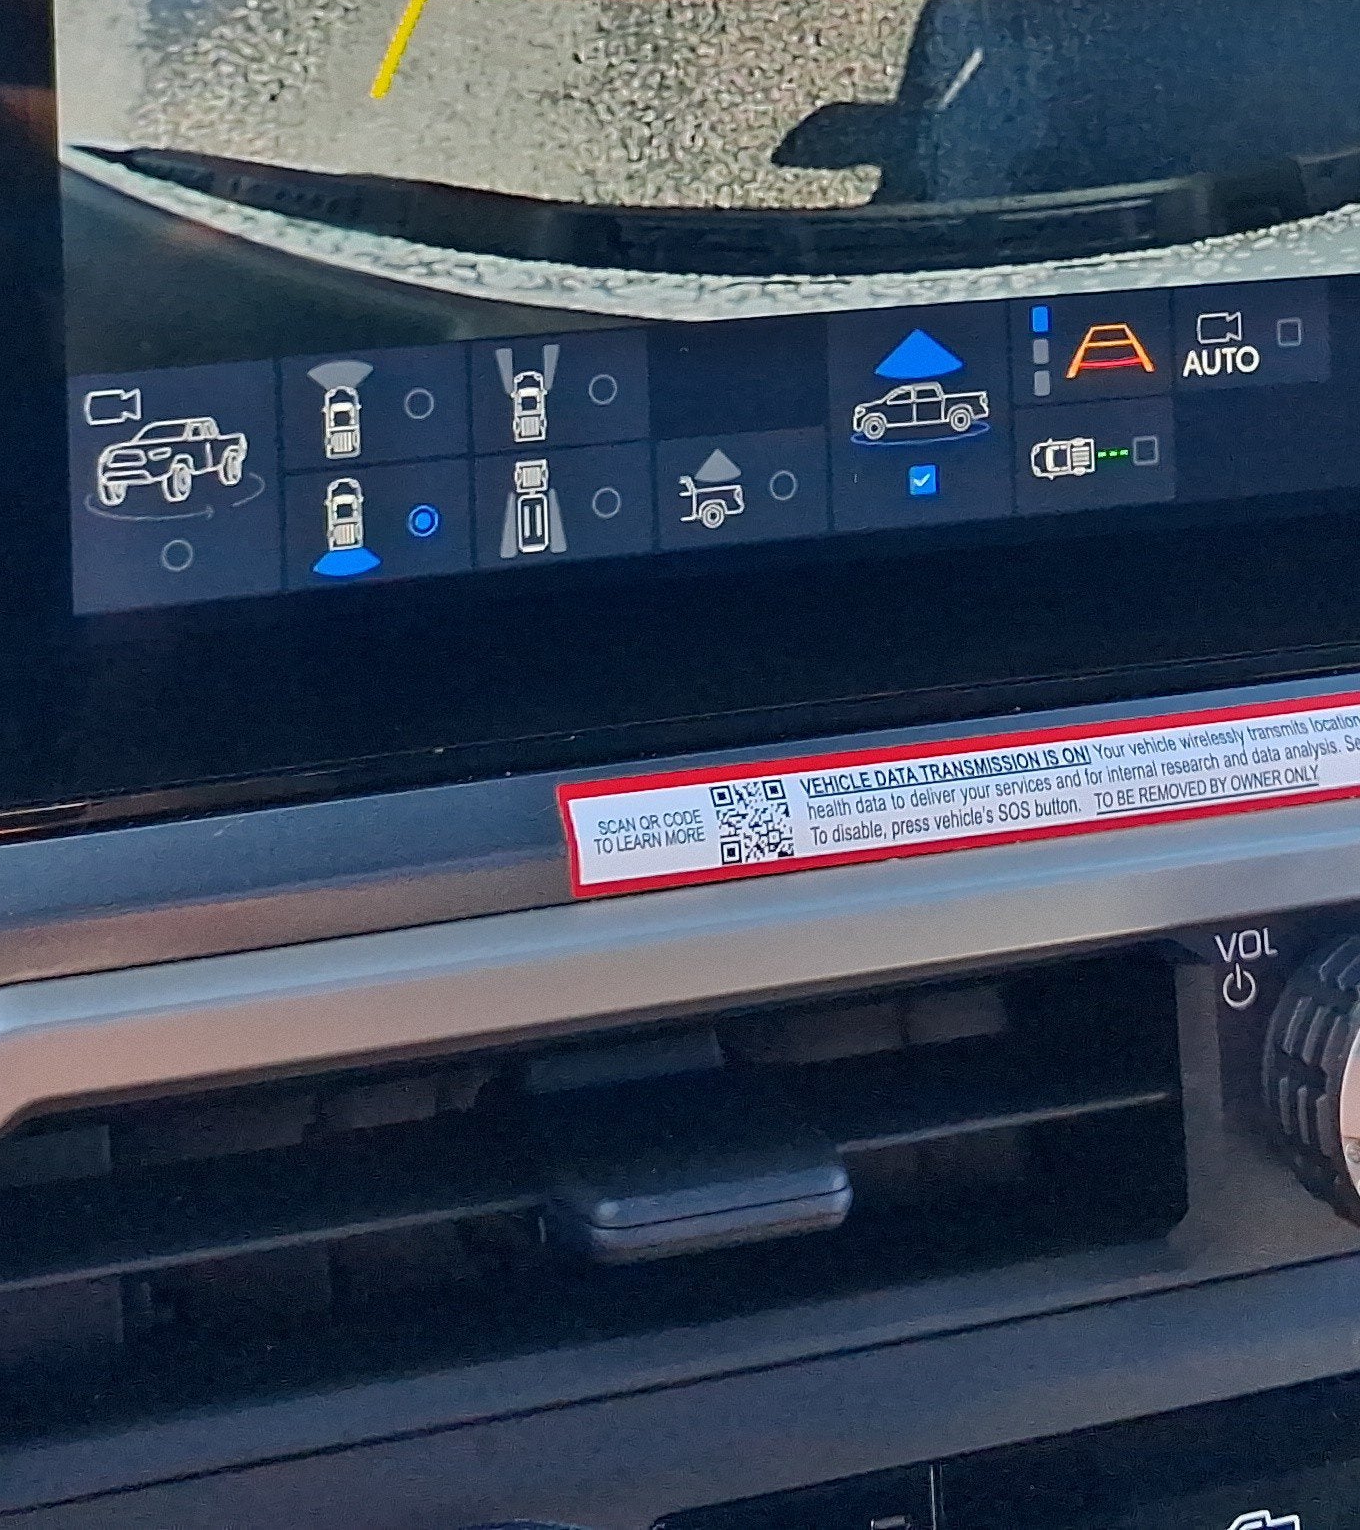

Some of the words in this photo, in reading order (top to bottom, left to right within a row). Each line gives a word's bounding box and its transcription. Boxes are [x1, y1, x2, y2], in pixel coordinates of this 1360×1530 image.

[1182, 345, 1260, 378] AUTO
[800, 770, 872, 797] VEHICLE
[875, 766, 918, 788] DATA
[921, 750, 1040, 783] TRANSMISSION
[1045, 748, 1059, 767] IS
[1093, 742, 1126, 761] Your
[1130, 735, 1177, 757] vehicle
[1180, 727, 1245, 751] wirelessly
[1247, 719, 1309, 742] transmits
[807, 796, 853, 821] health
[855, 794, 887, 814] data
[891, 791, 905, 810] to
[910, 785, 956, 807] deliver
[959, 785, 990, 805] your
[995, 775, 1052, 798] services
[1056, 770, 1082, 789] and
[1085, 769, 1103, 787] for
[1107, 760, 1158, 783] internal
[1160, 752, 1220, 777] research
[1224, 750, 1249, 769] and
[1252, 744, 1281, 765] data
[1285, 737, 1342, 761] analysis.
[597, 818, 636, 836] SCAN
[640, 814, 661, 831] QR
[664, 810, 703, 827] CODE
[810, 825, 828, 847] To
[832, 817, 888, 843] disable,
[891, 813, 931, 837] press
[934, 806, 994, 831] vehicle's
[998, 800, 1030, 822] SOS
[1034, 795, 1082, 818] button.
[1094, 792, 1114, 810] TO
[1117, 788, 1136, 807] BE
[1139, 778, 1207, 803] REMOVED
[1210, 776, 1228, 795] BY
[1231, 769, 1282, 792] OWNER
[1285, 764, 1320, 784] ONLY
[594, 837, 614, 856] TO
[616, 831, 662, 852] LEARN
[665, 826, 706, 846] MORE
[1214, 927, 1278, 963] VOL
